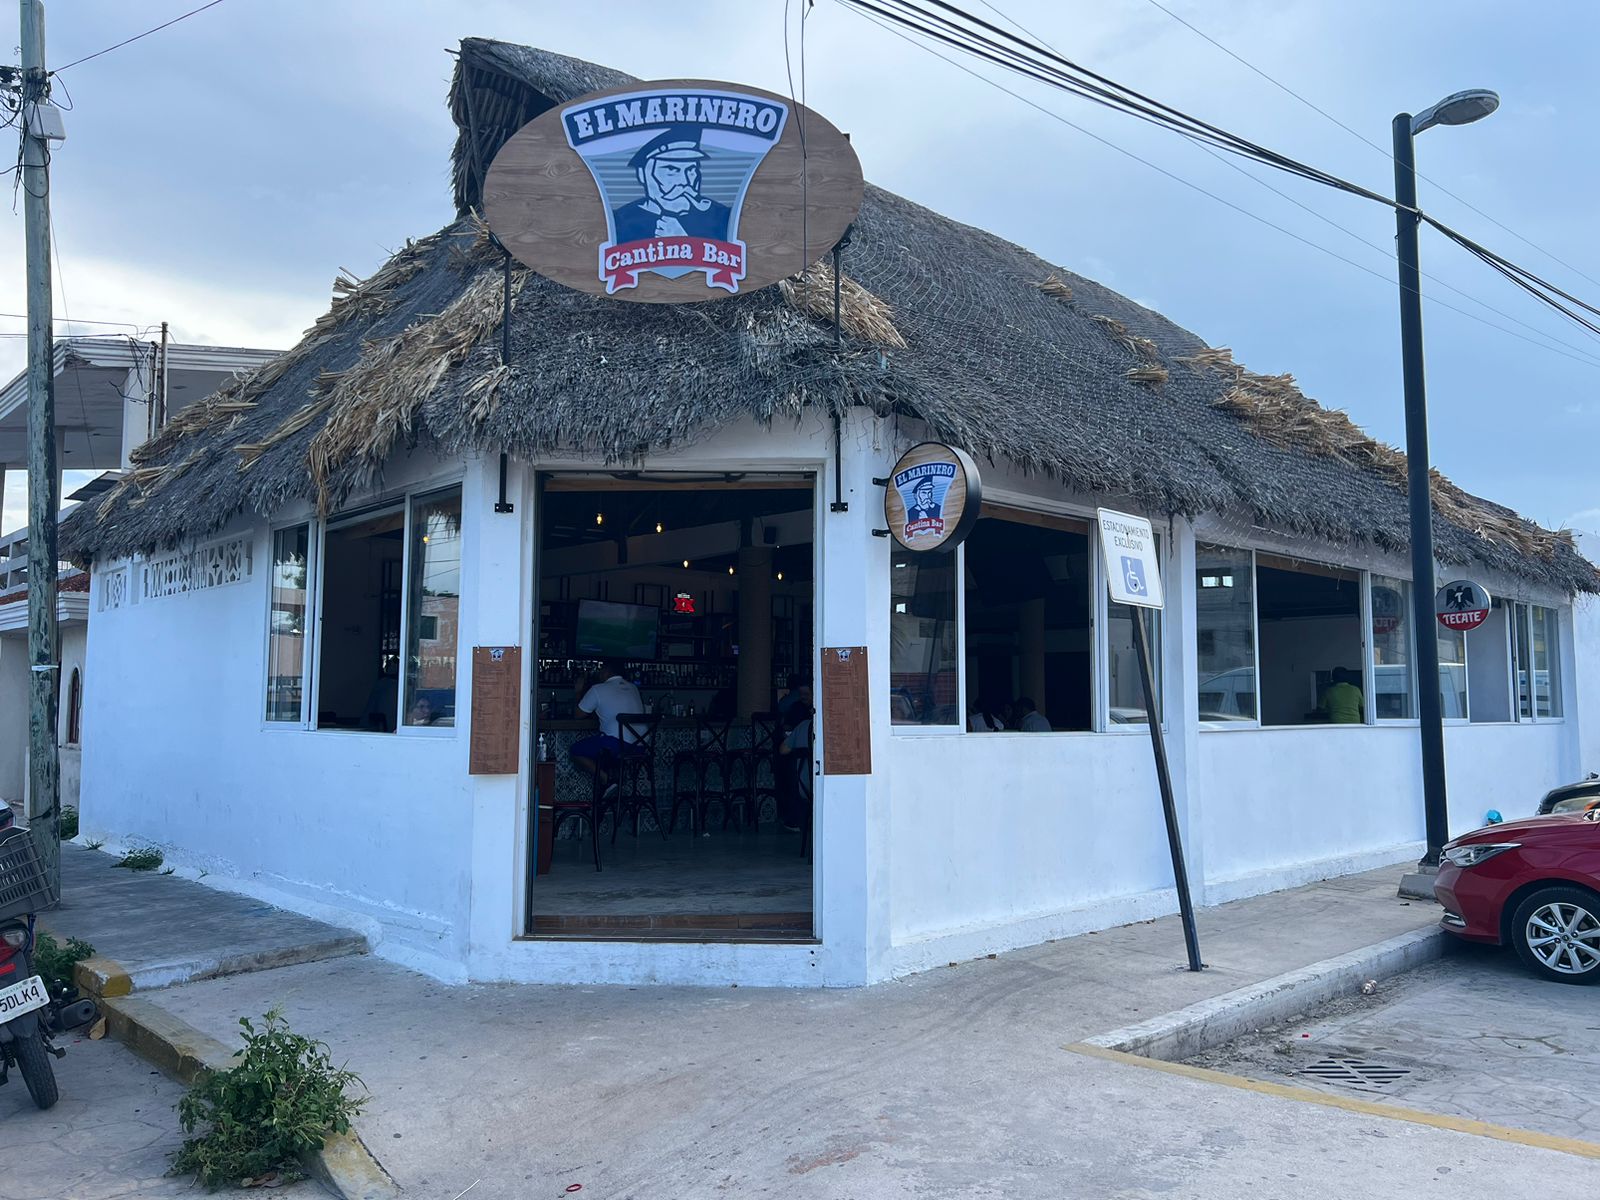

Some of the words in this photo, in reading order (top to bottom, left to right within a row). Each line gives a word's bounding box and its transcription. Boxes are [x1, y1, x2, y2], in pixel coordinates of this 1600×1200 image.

[574, 109, 614, 139] EL
[615, 97, 777, 133] MARINERO
[605, 241, 693, 271] Cantina
[702, 242, 741, 267] Bar
[896, 473, 908, 485] EL
[908, 464, 953, 482] MARINERO
[906, 520, 931, 532] Cantina
[1103, 520, 1150, 539] ESTACIONAMIENTO
[1114, 536, 1143, 552] EXCLUSIVO
[1442, 611, 1482, 625] TECATE
